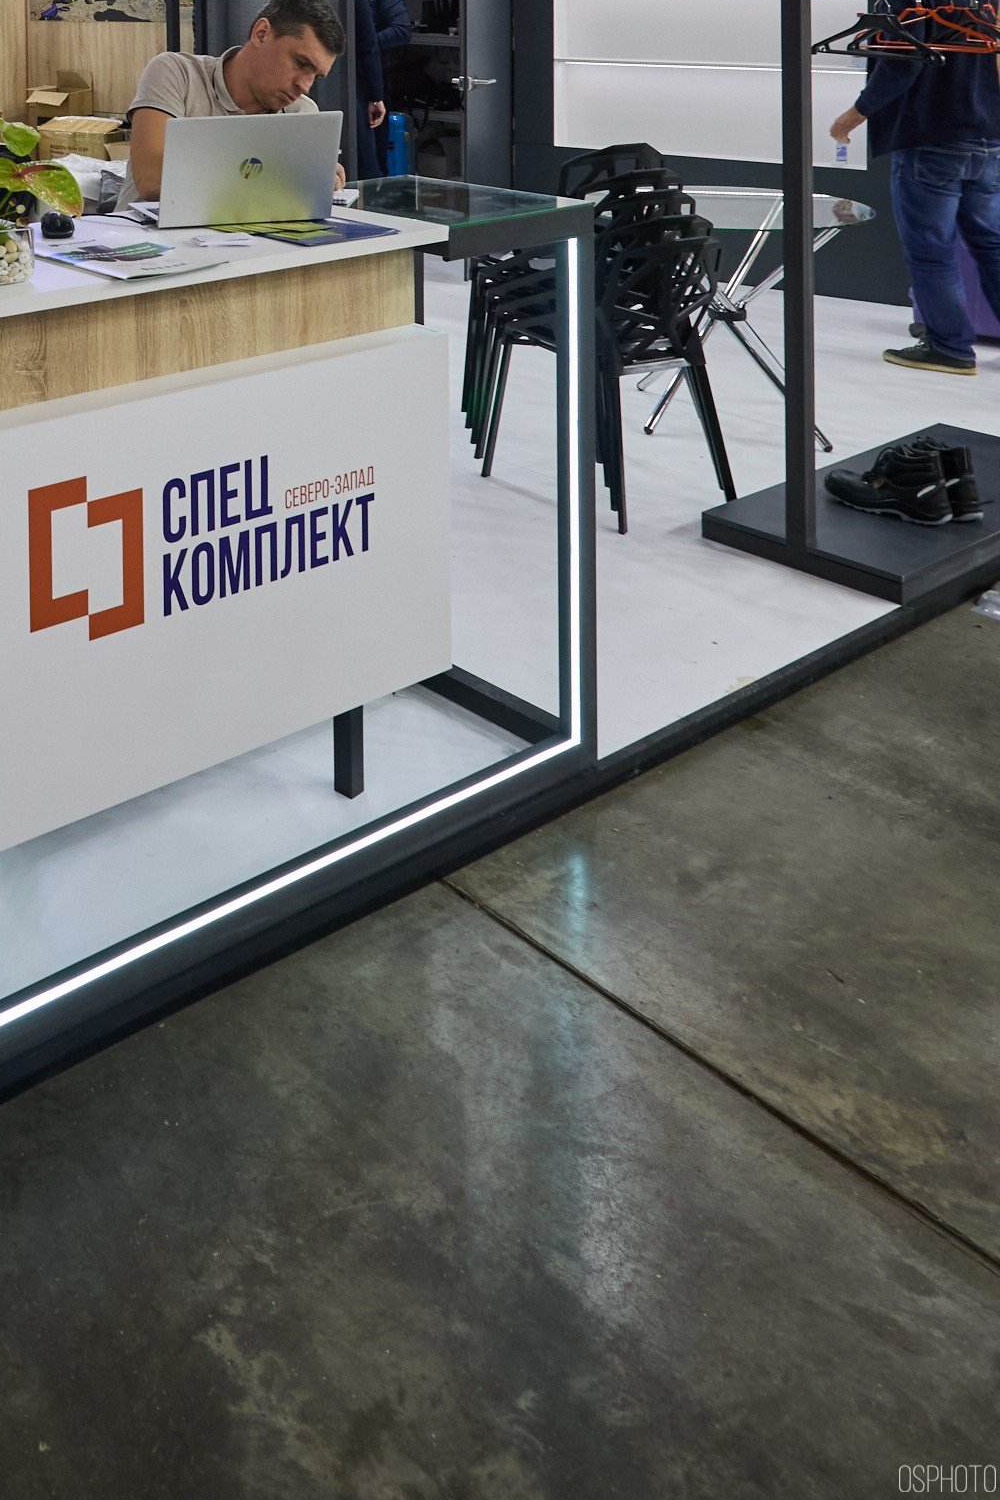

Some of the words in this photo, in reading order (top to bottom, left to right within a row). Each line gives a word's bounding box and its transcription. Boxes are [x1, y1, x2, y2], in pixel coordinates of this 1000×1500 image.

[162, 454, 273, 543] СПЕЦ
[284, 465, 375, 510] СЕВЕРО-ЗАПАД
[162, 492, 375, 617] КОМПЛЕКТ
